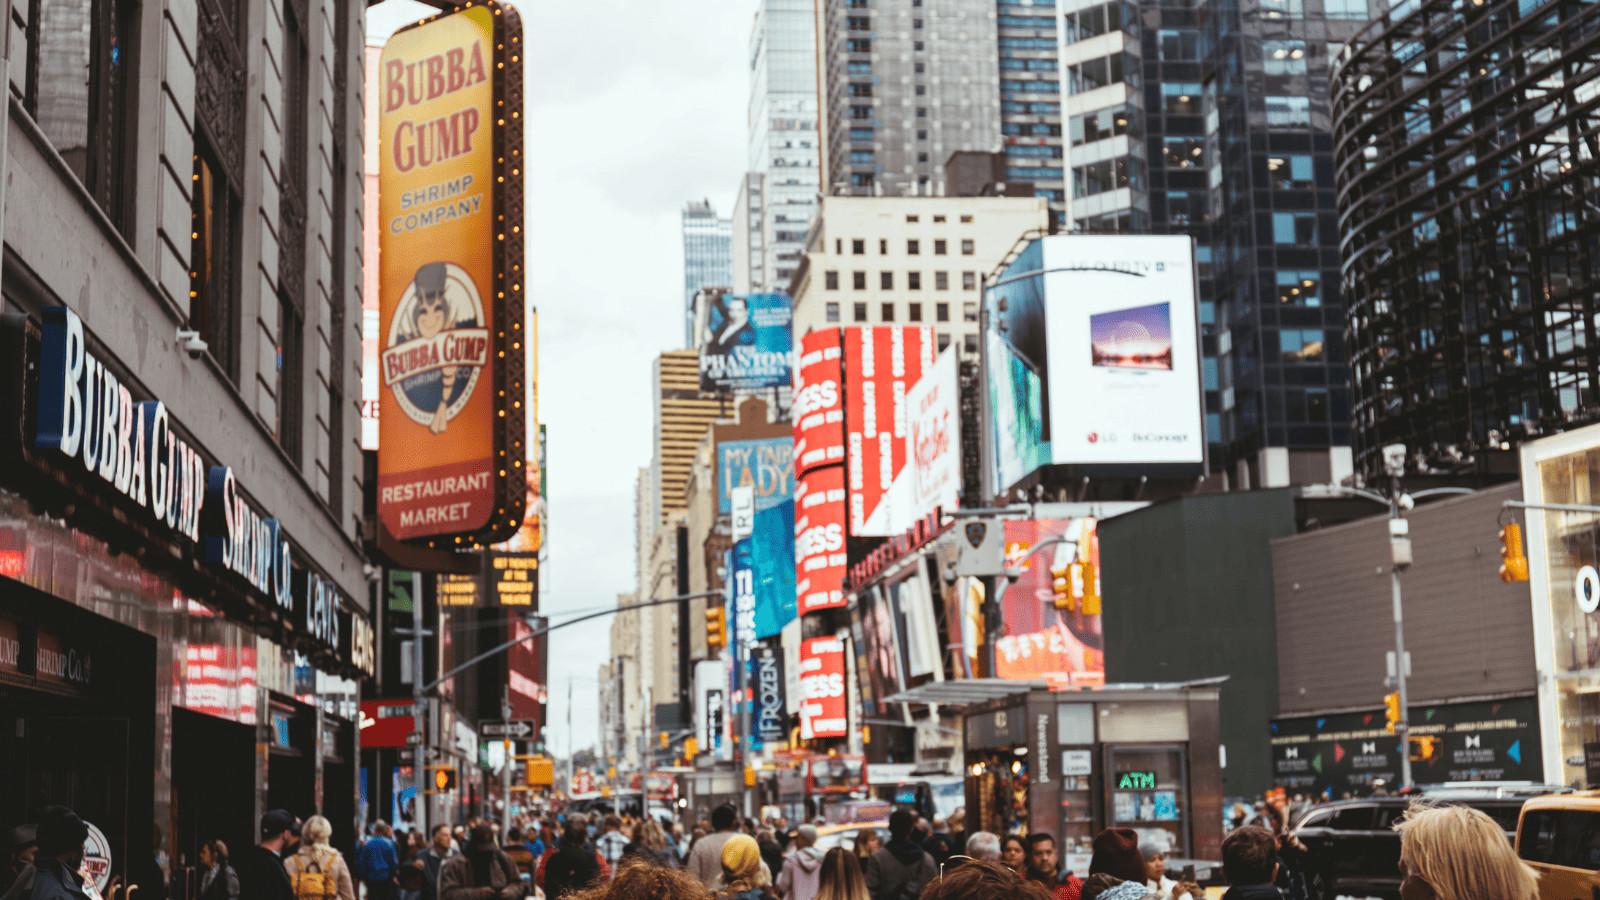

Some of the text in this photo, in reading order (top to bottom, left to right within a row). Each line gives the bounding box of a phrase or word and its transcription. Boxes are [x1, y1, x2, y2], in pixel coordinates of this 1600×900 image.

[384, 38, 487, 114] BUBBA
[392, 106, 479, 173] GUMP
[401, 174, 474, 210] SHRIMP
[390, 194, 483, 235] COMPANY
[386, 333, 486, 380] BUBBA GUMP
[60, 305, 147, 507] BUBBA
[151, 401, 205, 543] GUMP
[222, 466, 272, 596] SHRIMP
[725, 446, 753, 468] MY
[382, 471, 490, 503] RESTAURANT
[725, 463, 793, 498] LADY
[400, 502, 471, 528] MARKET
[759, 657, 783, 738] FROZEN
[1037, 714, 1050, 783] Newsstand
[1119, 771, 1155, 788] ATM
